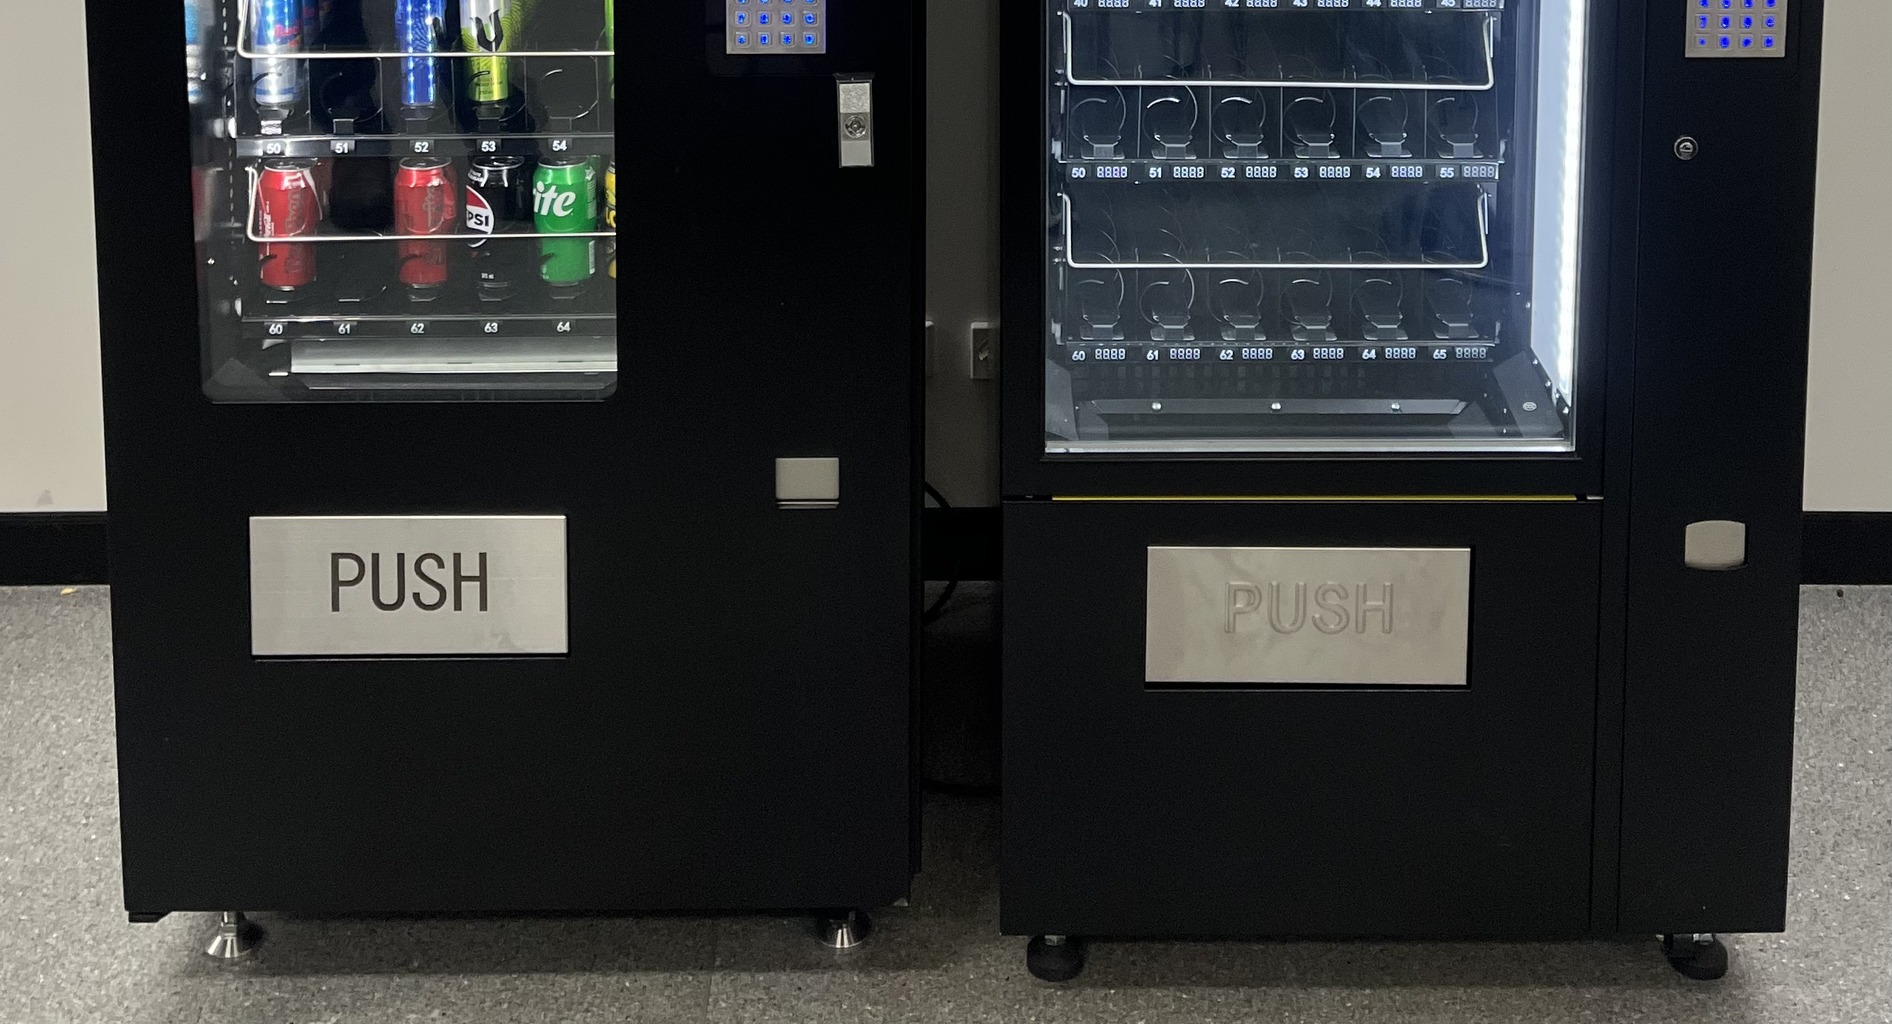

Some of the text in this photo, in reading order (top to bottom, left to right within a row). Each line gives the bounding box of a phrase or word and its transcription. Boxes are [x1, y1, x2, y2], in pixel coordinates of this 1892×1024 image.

[335, 143, 348, 154] 51
[414, 142, 429, 153] 52
[481, 141, 496, 152] 53
[552, 140, 568, 151] 54
[1071, 167, 1086, 178] 50
[1149, 167, 1162, 178] 51
[1220, 167, 1236, 178] 52
[1293, 167, 1309, 178] 53
[1365, 167, 1381, 178] 54
[1439, 167, 1455, 178] 55
[533, 181, 576, 217] ite
[269, 323, 283, 334] 60
[338, 323, 351, 334] 61
[410, 323, 425, 334] 62
[484, 322, 498, 333] 63
[556, 321, 571, 332] 64
[1072, 349, 1086, 360] 60
[1146, 349, 1159, 360] 61
[1219, 349, 1233, 360] 62
[1291, 349, 1305, 360] 63
[1362, 349, 1376, 360] 64
[1432, 349, 1447, 360] 65
[330, 552, 488, 612] PUSH
[1224, 581, 1394, 634] PUSH
